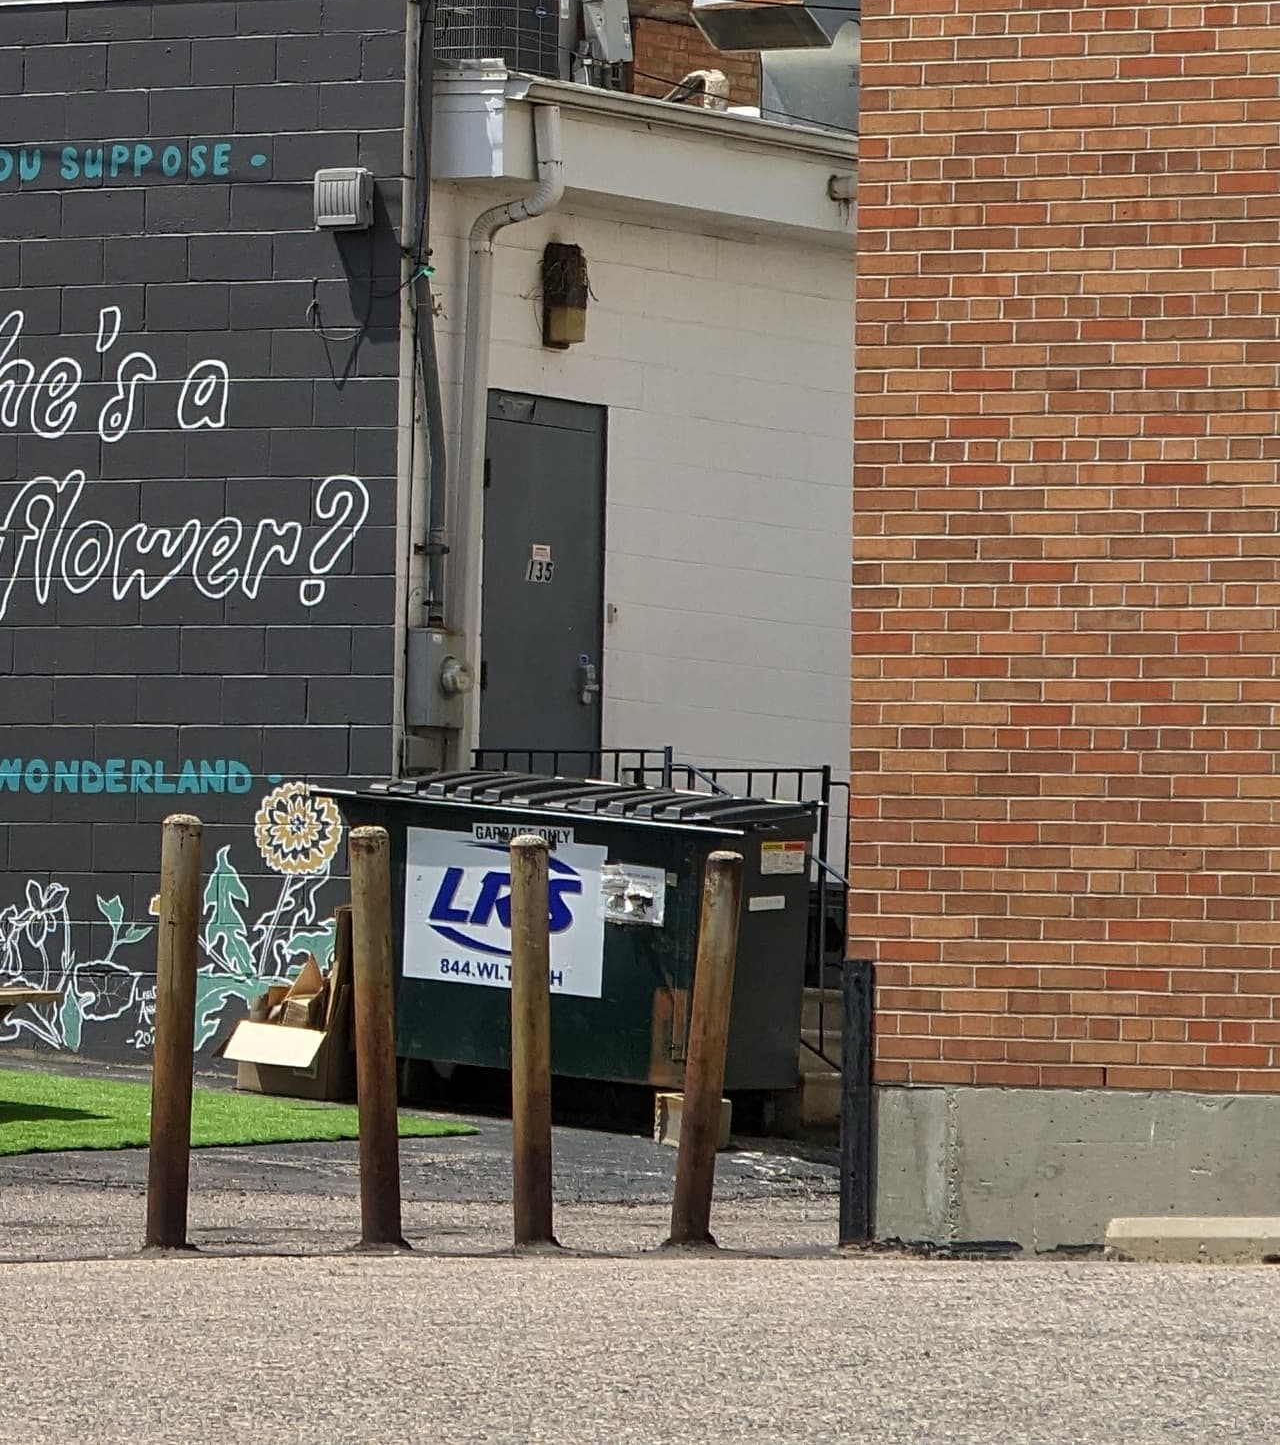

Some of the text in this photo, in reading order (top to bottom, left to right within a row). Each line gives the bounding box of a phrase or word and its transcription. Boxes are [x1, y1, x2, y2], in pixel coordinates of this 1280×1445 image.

[59, 142, 233, 181] SUPPOSE
[177, 358, 230, 431] a
[528, 561, 553, 581] 135
[539, 828, 571, 843] ONLY
[428, 866, 584, 933] LRS
[440, 958, 564, 987] 844.WI.TH
